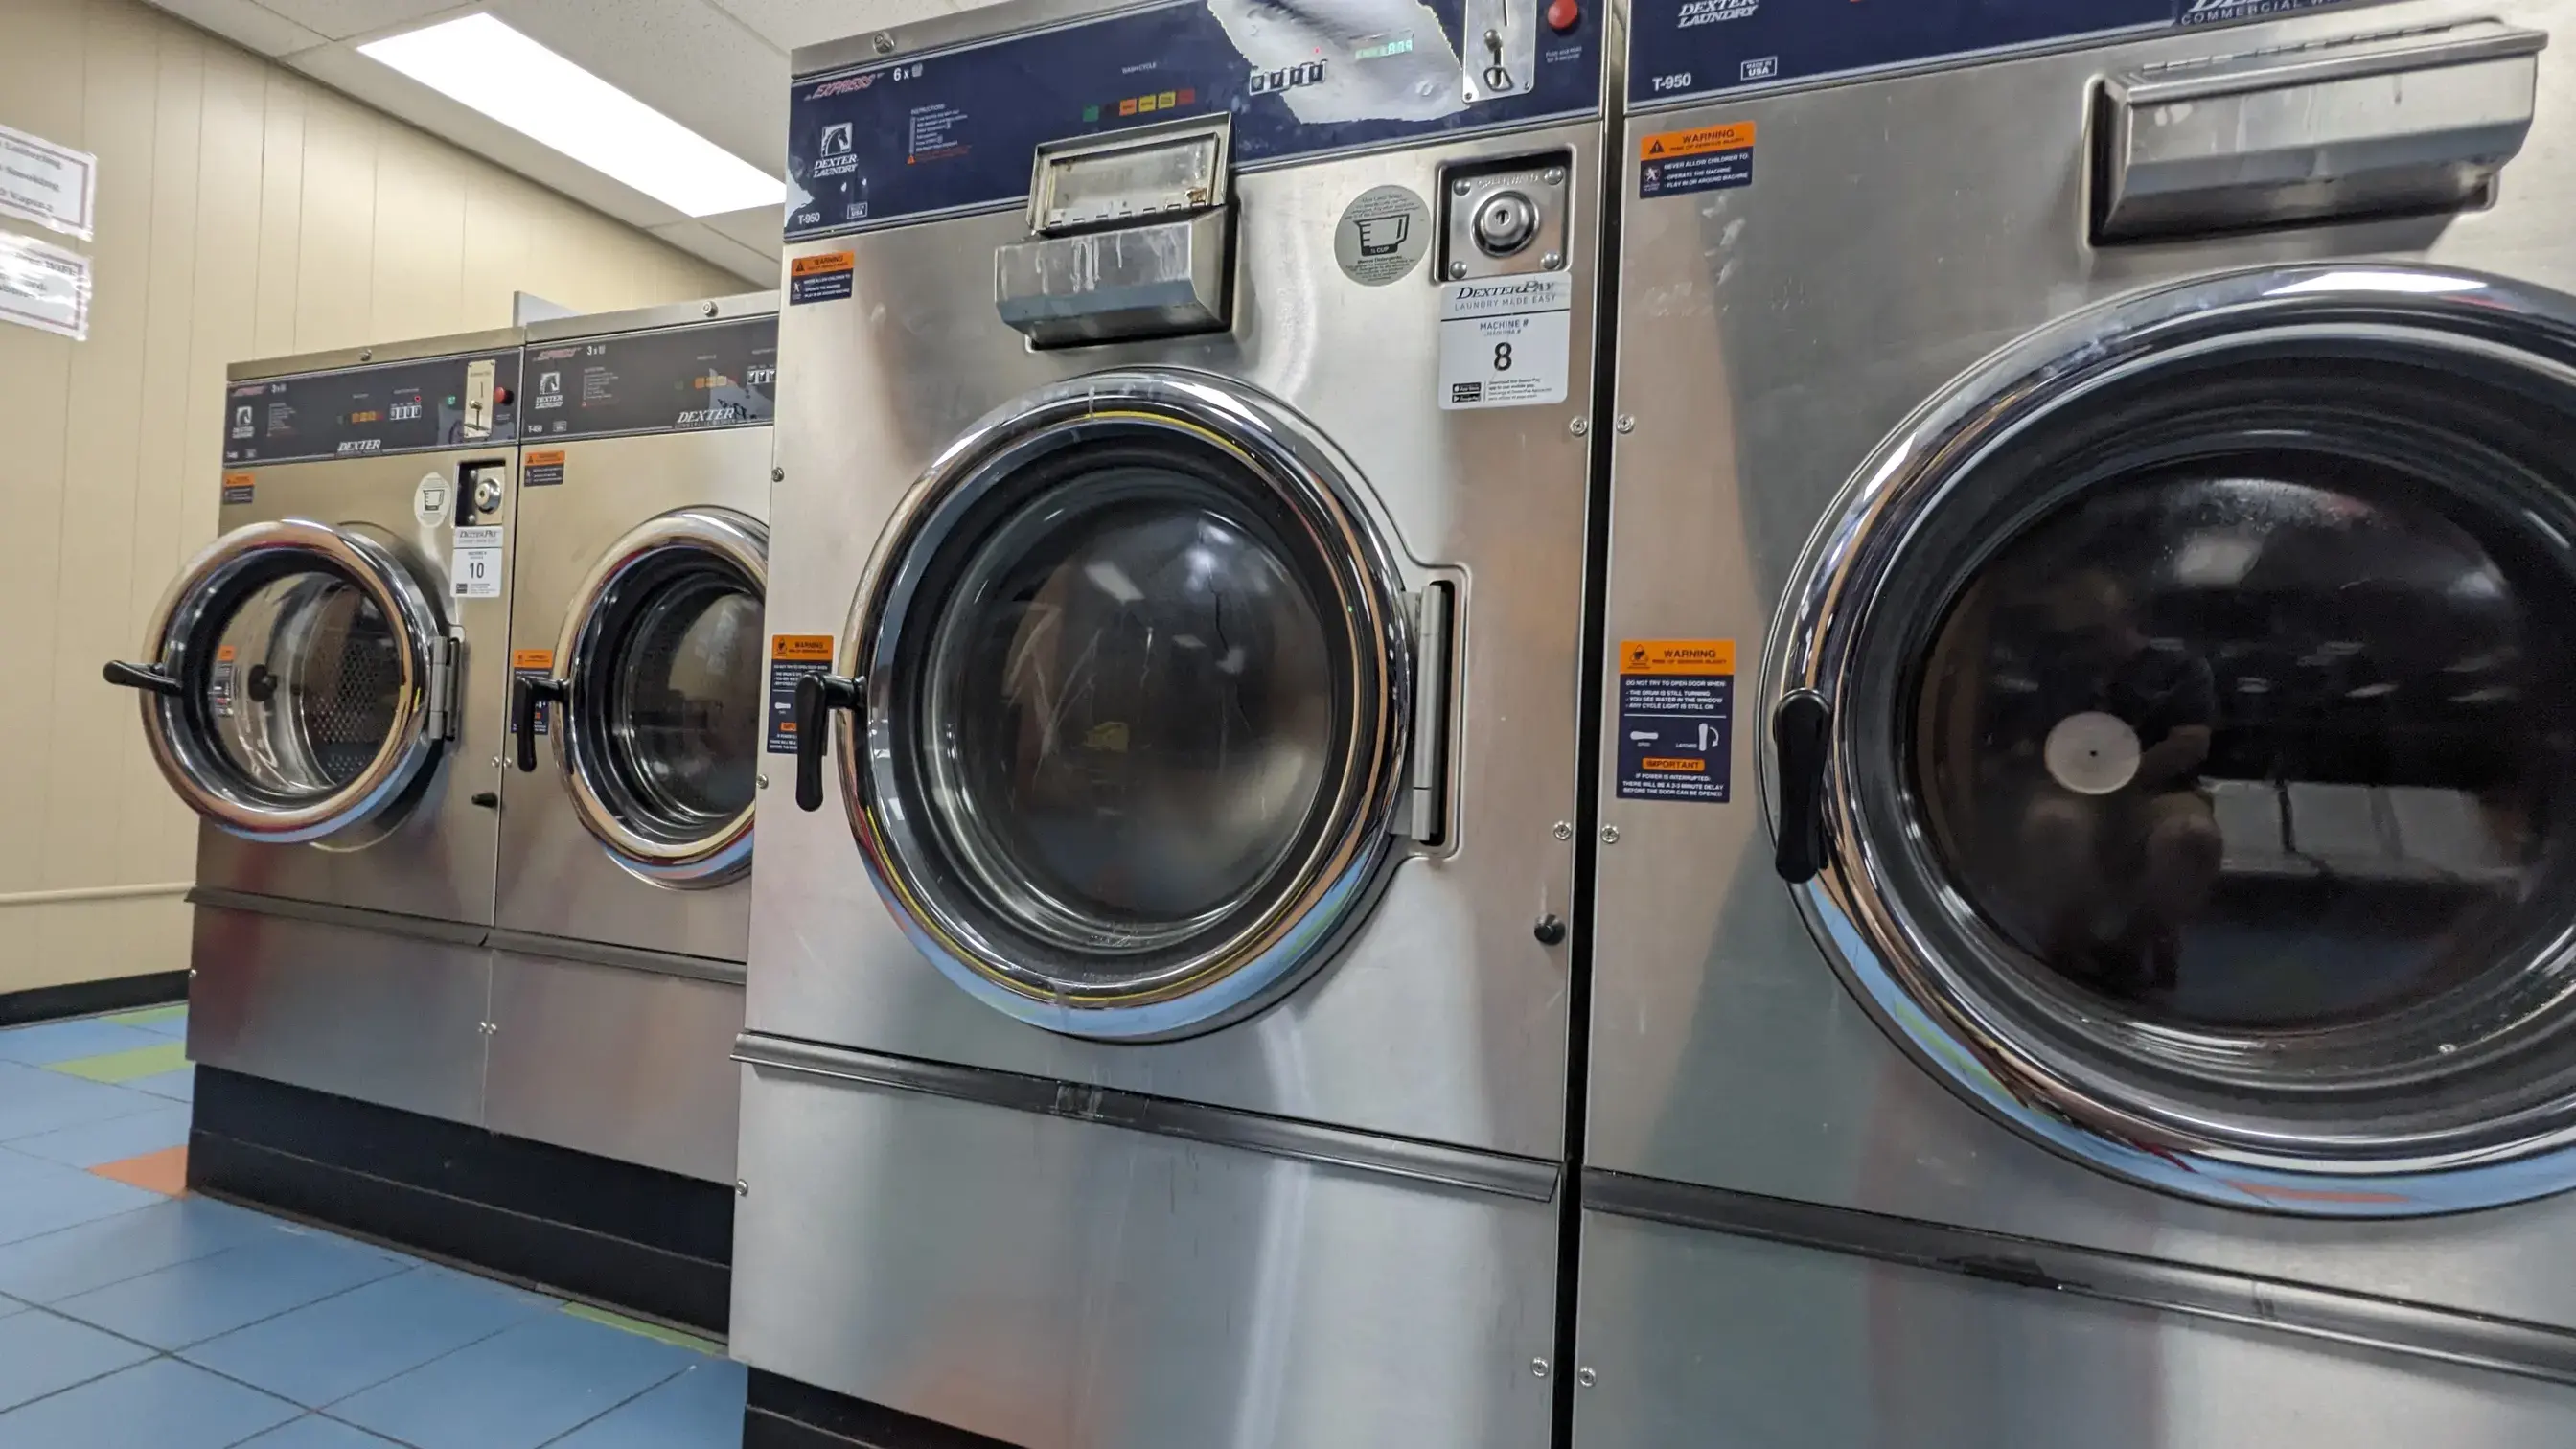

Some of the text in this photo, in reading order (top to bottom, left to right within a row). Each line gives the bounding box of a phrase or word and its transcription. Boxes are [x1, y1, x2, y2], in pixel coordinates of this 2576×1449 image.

[1678, 5, 1759, 29] LAUNDRY
[2181, 0, 2299, 26] COMMERCIAL
[894, 67, 900, 81] 6
[1748, 67, 1769, 77] USA
[812, 74, 875, 99] EXPRESS
[1652, 72, 1691, 92] T-950
[1682, 129, 1735, 144] WARNING
[814, 153, 858, 170] DEXTER
[1664, 161, 1685, 170] NEVER
[1707, 154, 1737, 164] CHILDREN
[813, 164, 858, 178] LAUNDRY
[1667, 172, 1692, 180] OPERATE
[1705, 166, 1732, 174] MACHINE
[1697, 175, 1722, 184] AROUND
[1723, 172, 1748, 181] MACHINE
[798, 212, 820, 225] T-950
[1454, 292, 1556, 311] LAUNDRY MADE EASY
[1480, 318, 1529, 331] MACHINE #
[586, 345, 592, 356] 3
[1493, 341, 1512, 371] 8
[677, 407, 735, 424] DEXTER
[337, 439, 381, 452] DEXTER
[469, 562, 485, 579] 10
[1664, 650, 1715, 658] WARNING
[1646, 760, 1699, 769] IMPORTANT
